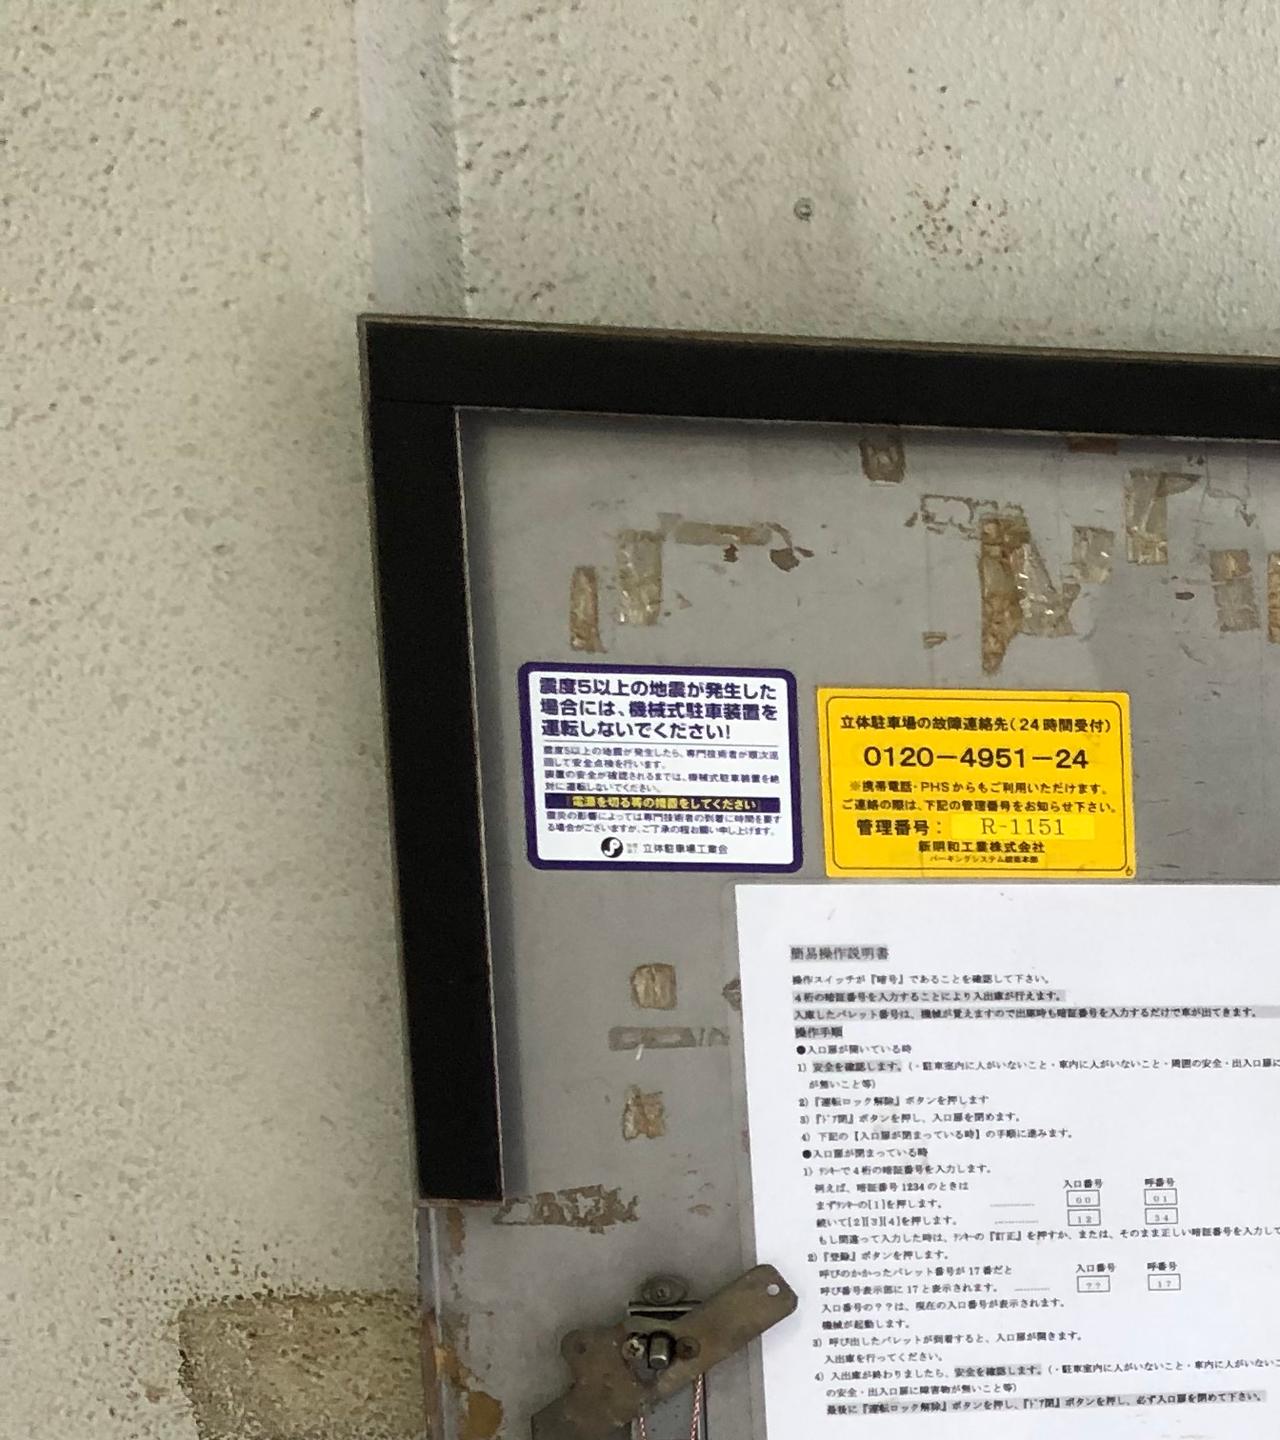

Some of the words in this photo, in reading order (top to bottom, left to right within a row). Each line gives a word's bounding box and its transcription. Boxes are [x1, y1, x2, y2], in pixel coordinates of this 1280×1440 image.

[539, 676, 777, 701] 震度5以上の地震が発生した
[541, 698, 778, 722] 場合には、機械式駐車装置を
[542, 719, 731, 741] 運転しないでください!
[980, 817, 1066, 836] R-1151
[790, 945, 890, 961] 簡易操作説明書
[794, 1026, 844, 1039] 操作手順
[1063, 1178, 1103, 1190] 入口番号
[1144, 1177, 1175, 1188] 呼番号
[1075, 1262, 1115, 1274] 入口番号
[1146, 1261, 1178, 1272] 呼番号
